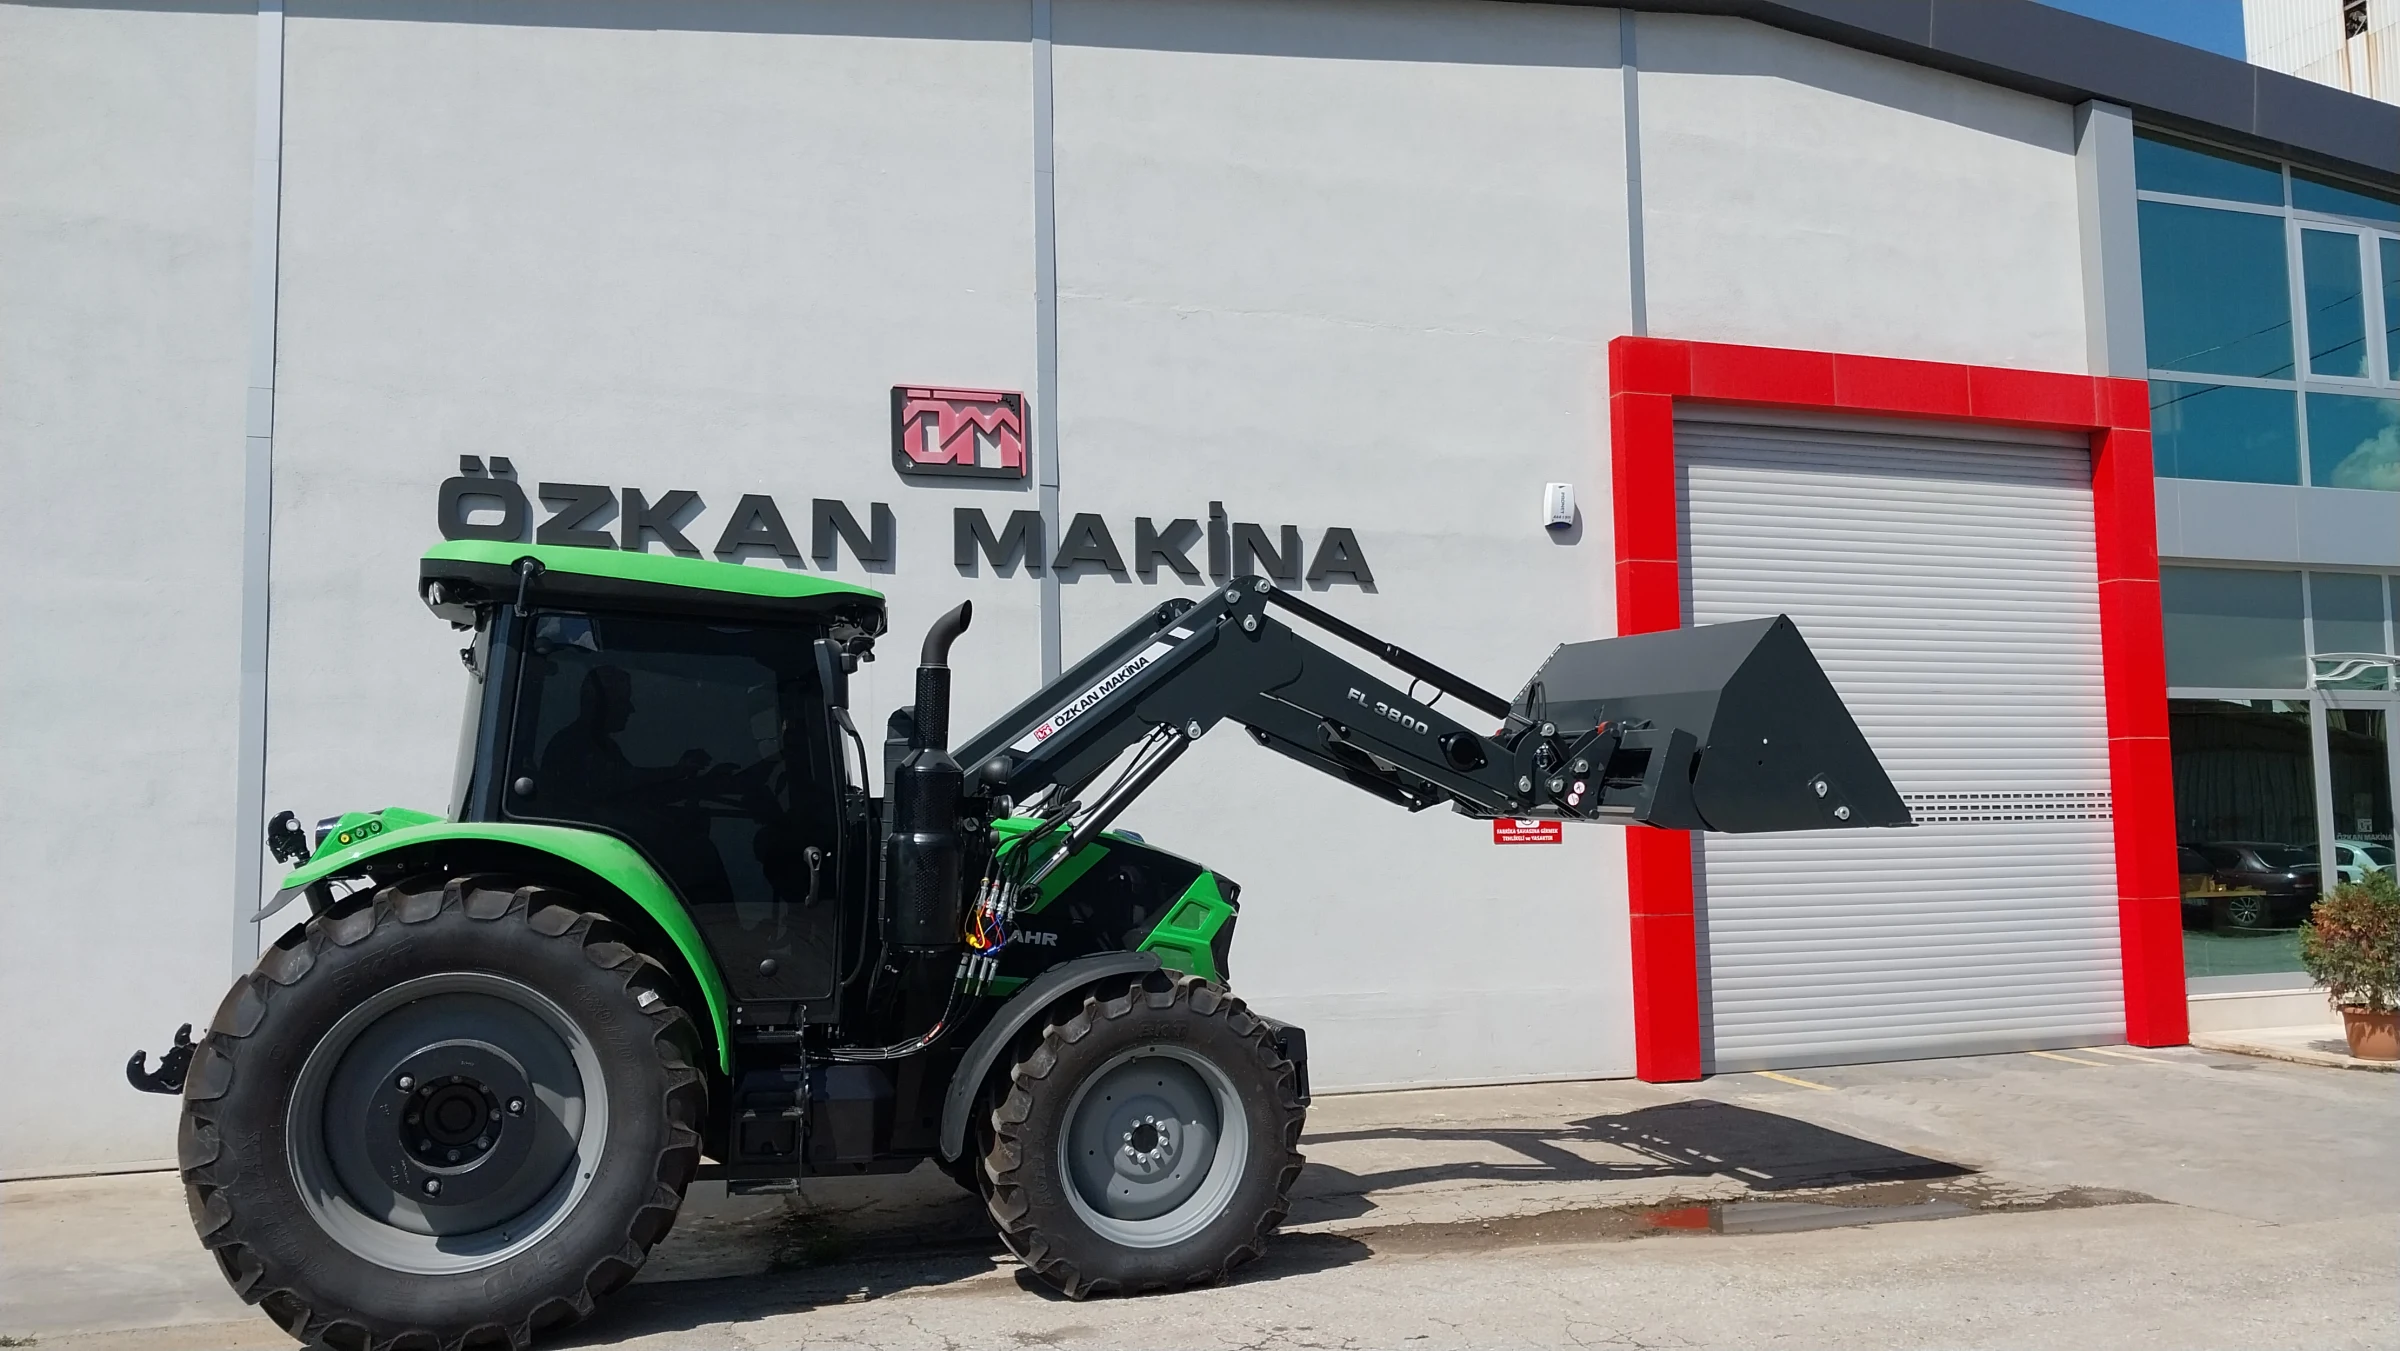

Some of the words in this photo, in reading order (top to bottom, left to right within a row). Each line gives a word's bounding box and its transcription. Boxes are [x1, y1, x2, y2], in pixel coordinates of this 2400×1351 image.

[437, 454, 890, 562] ÖZKAN
[954, 501, 1375, 583] MAKİNA
[1054, 691, 1101, 728] ÖZKAN
[1098, 656, 1150, 695] MAKİNA
[1347, 687, 1369, 708] FL
[1374, 701, 1429, 735] 3800
